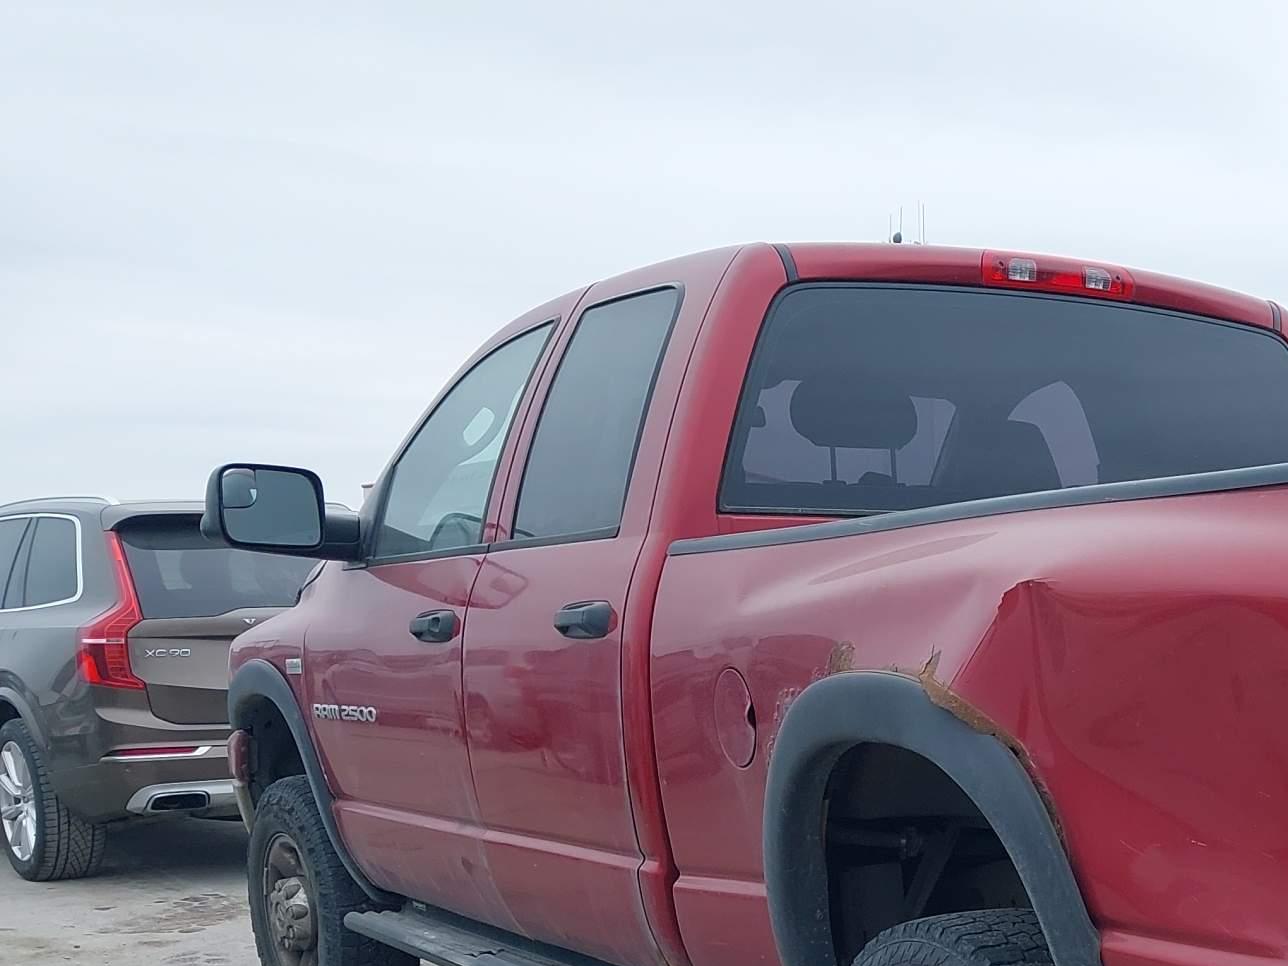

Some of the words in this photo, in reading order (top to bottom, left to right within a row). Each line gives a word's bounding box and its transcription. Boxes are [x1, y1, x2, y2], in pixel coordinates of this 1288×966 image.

[144, 648, 191, 658] XC90
[312, 703, 339, 720] RAM
[340, 705, 377, 722] 2500
